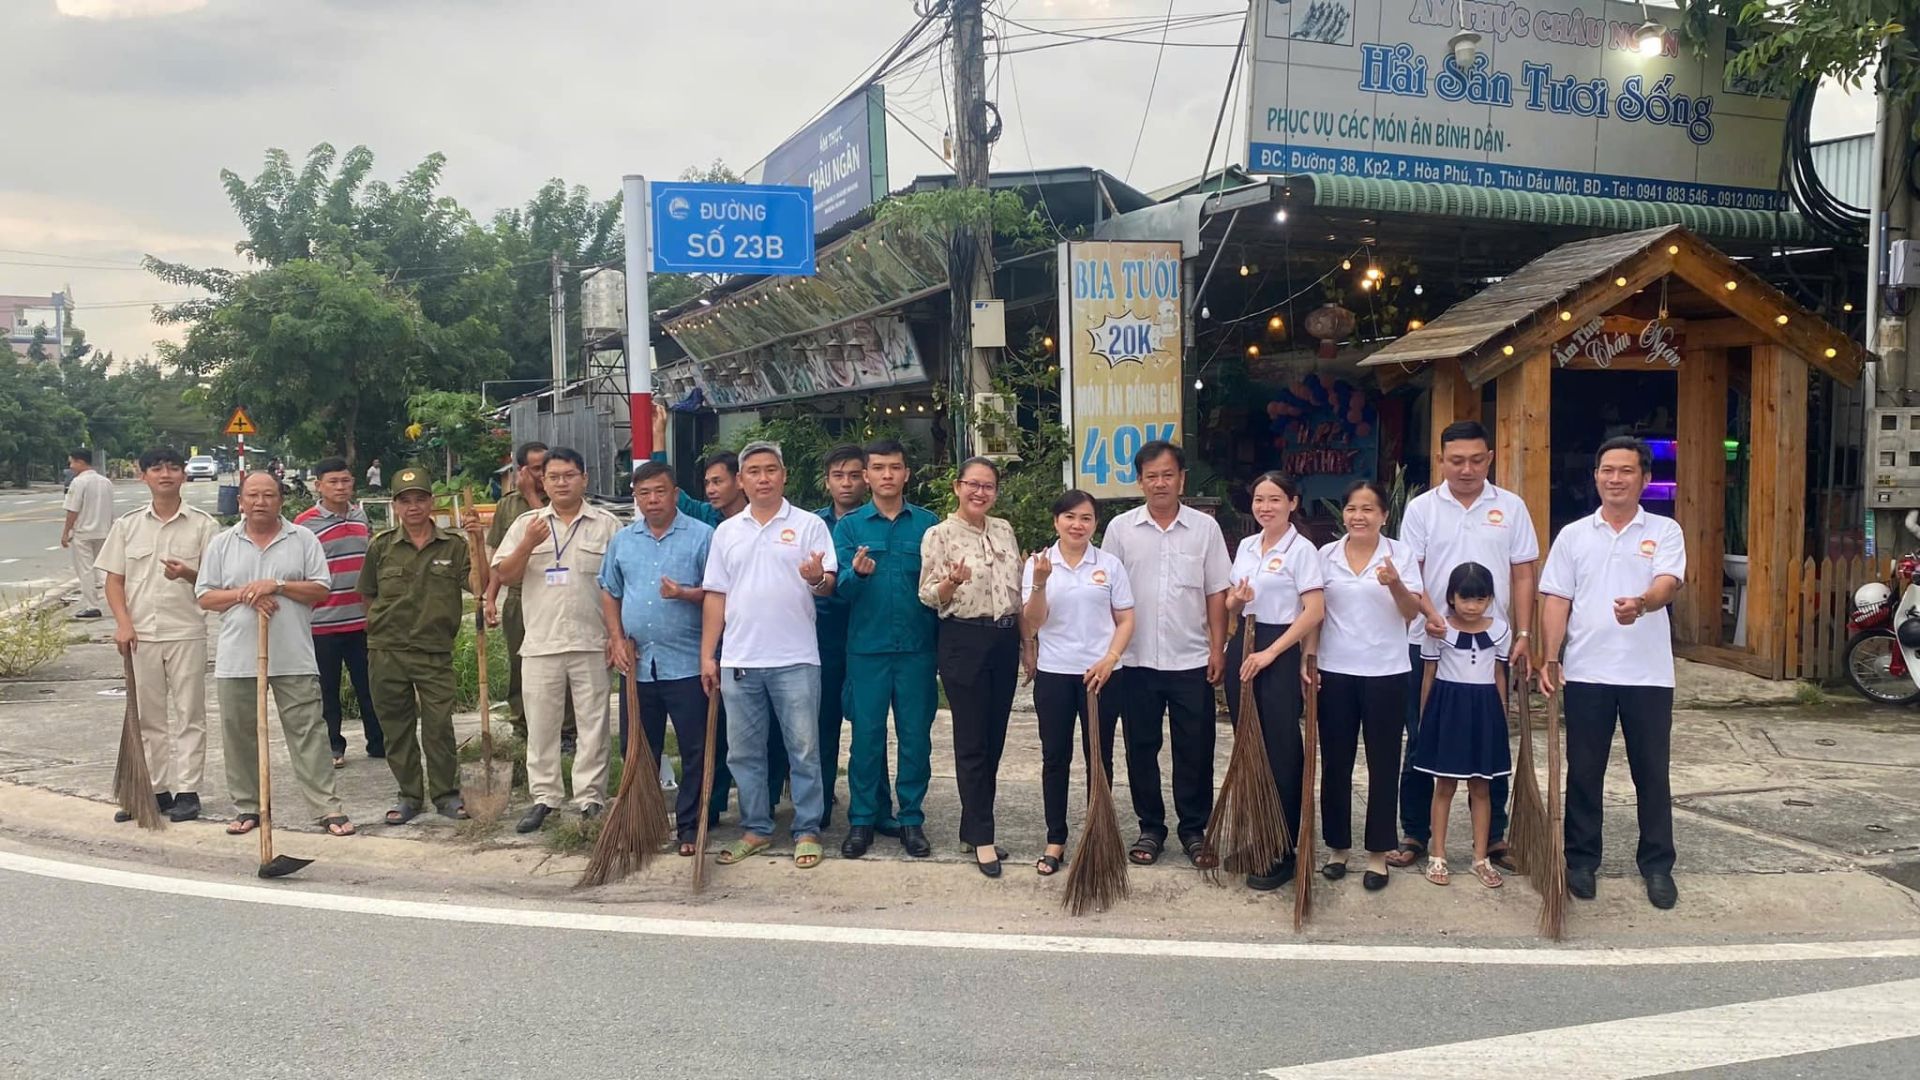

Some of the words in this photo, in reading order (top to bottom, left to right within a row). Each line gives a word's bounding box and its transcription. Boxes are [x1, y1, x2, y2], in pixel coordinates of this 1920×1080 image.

[1533, 8, 1605, 48] CHÂU
[1360, 43, 1428, 97] Hải
[1435, 52, 1513, 107] Sản
[1522, 60, 1609, 118] Tươi
[1615, 74, 1714, 145] Sống
[1267, 107, 1309, 138] PHỤC
[1314, 113, 1334, 142] VỤ
[1338, 109, 1369, 139] CÁC
[1373, 113, 1407, 143] MÓN
[1411, 117, 1431, 145] ĂN
[1436, 118, 1470, 149] BÌNH
[832, 142, 860, 184] NGÂN
[1261, 150, 1286, 167] ĐC:
[1292, 152, 1336, 173] Đường
[1340, 158, 1359, 174] 38,
[1364, 159, 1393, 178] Kp2,
[1398, 161, 1410, 178] P.
[1414, 162, 1439, 179] Hòa
[1443, 163, 1472, 184] Phú,
[1476, 167, 1495, 184] Tp.
[1500, 170, 1523, 187] Thủ
[1527, 171, 1551, 190] Dầu
[1554, 175, 1580, 195] Một,
[1583, 178, 1601, 194] BD
[1612, 180, 1634, 198] Tel:
[1636, 183, 1662, 200] 0941
[1666, 186, 1686, 202] 883
[1689, 188, 1708, 205] 546
[1718, 191, 1743, 207] 0912
[1745, 194, 1765, 208] 009
[700, 199, 767, 221] ĐƯỜNG
[687, 224, 726, 258] SỐ
[733, 234, 784, 259] 23B
[1074, 258, 1116, 300] BIA
[1121, 251, 1180, 300] TƯƠI
[1108, 324, 1152, 355] 20K
[1585, 331, 1632, 369] Châu
[1638, 318, 1681, 368] Ngân
[1075, 378, 1104, 416] MÓN
